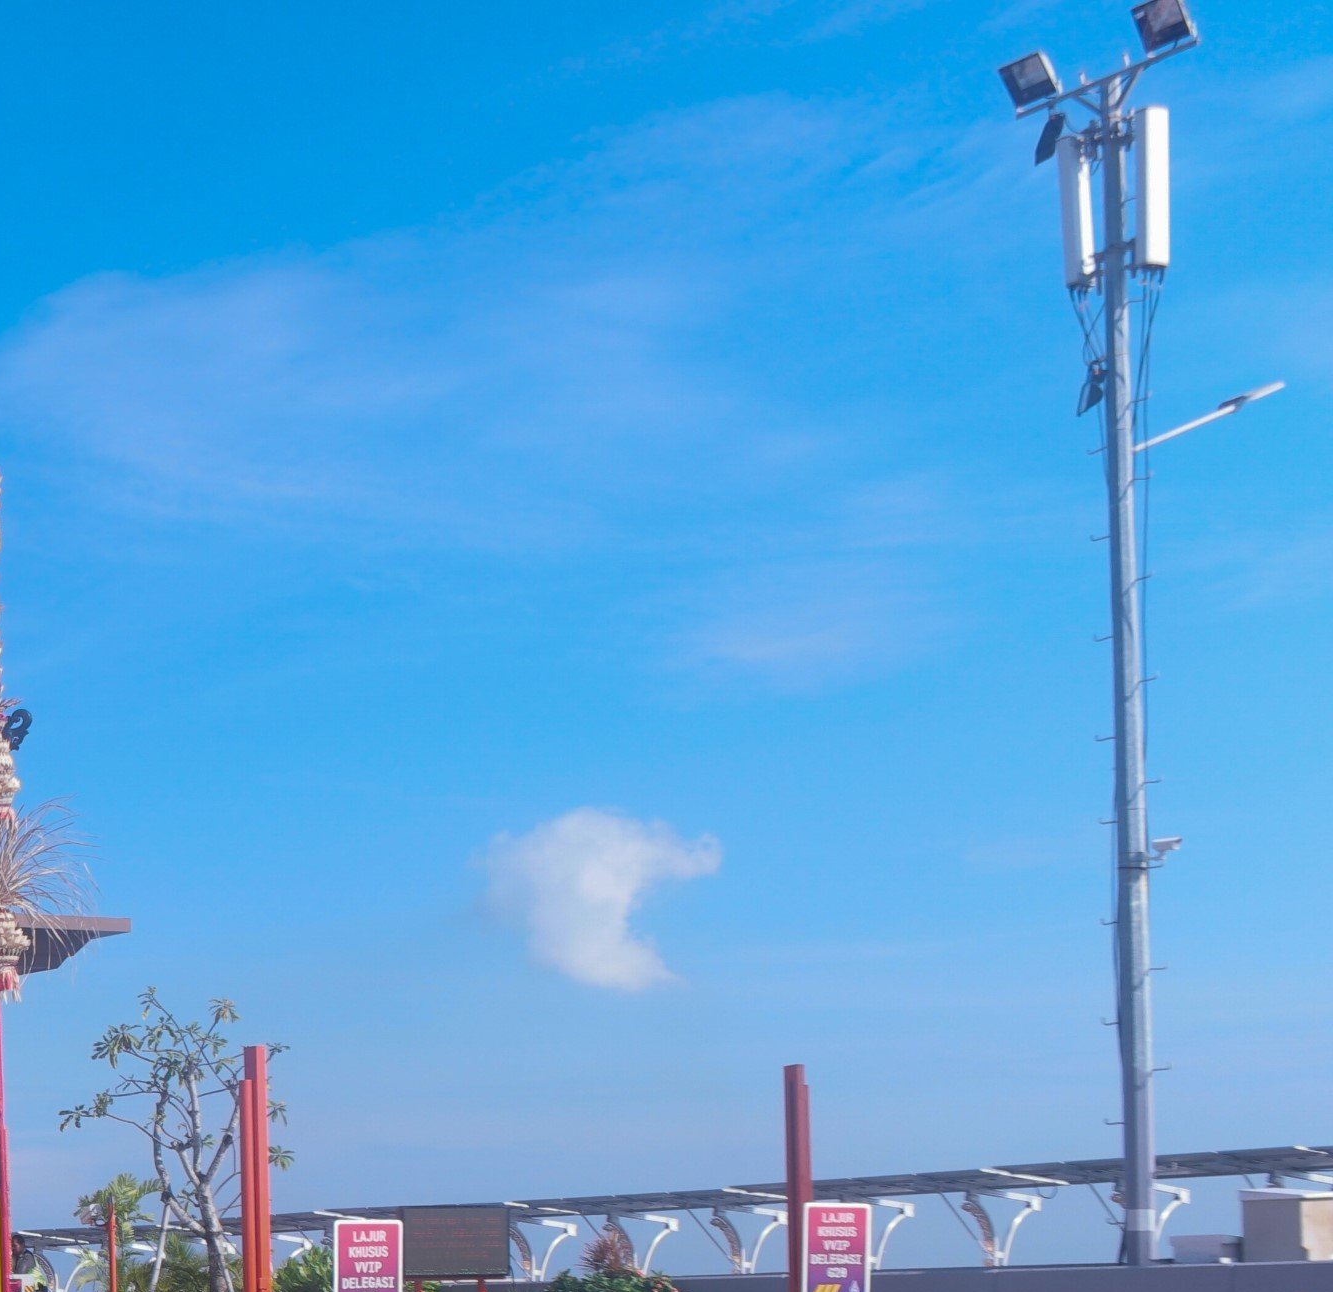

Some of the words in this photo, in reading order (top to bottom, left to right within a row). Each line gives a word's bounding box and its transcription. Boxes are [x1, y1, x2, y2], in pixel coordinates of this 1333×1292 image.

[821, 1212, 855, 1223] LAJUR
[353, 1231, 386, 1242] LAJUR
[817, 1226, 858, 1237] KHUSUS
[822, 1239, 851, 1250] VVIP
[348, 1246, 389, 1258] KHUSUS
[810, 1253, 863, 1265] DELEGASI
[354, 1262, 382, 1273] VVIP
[342, 1277, 395, 1289] DELEGASI
